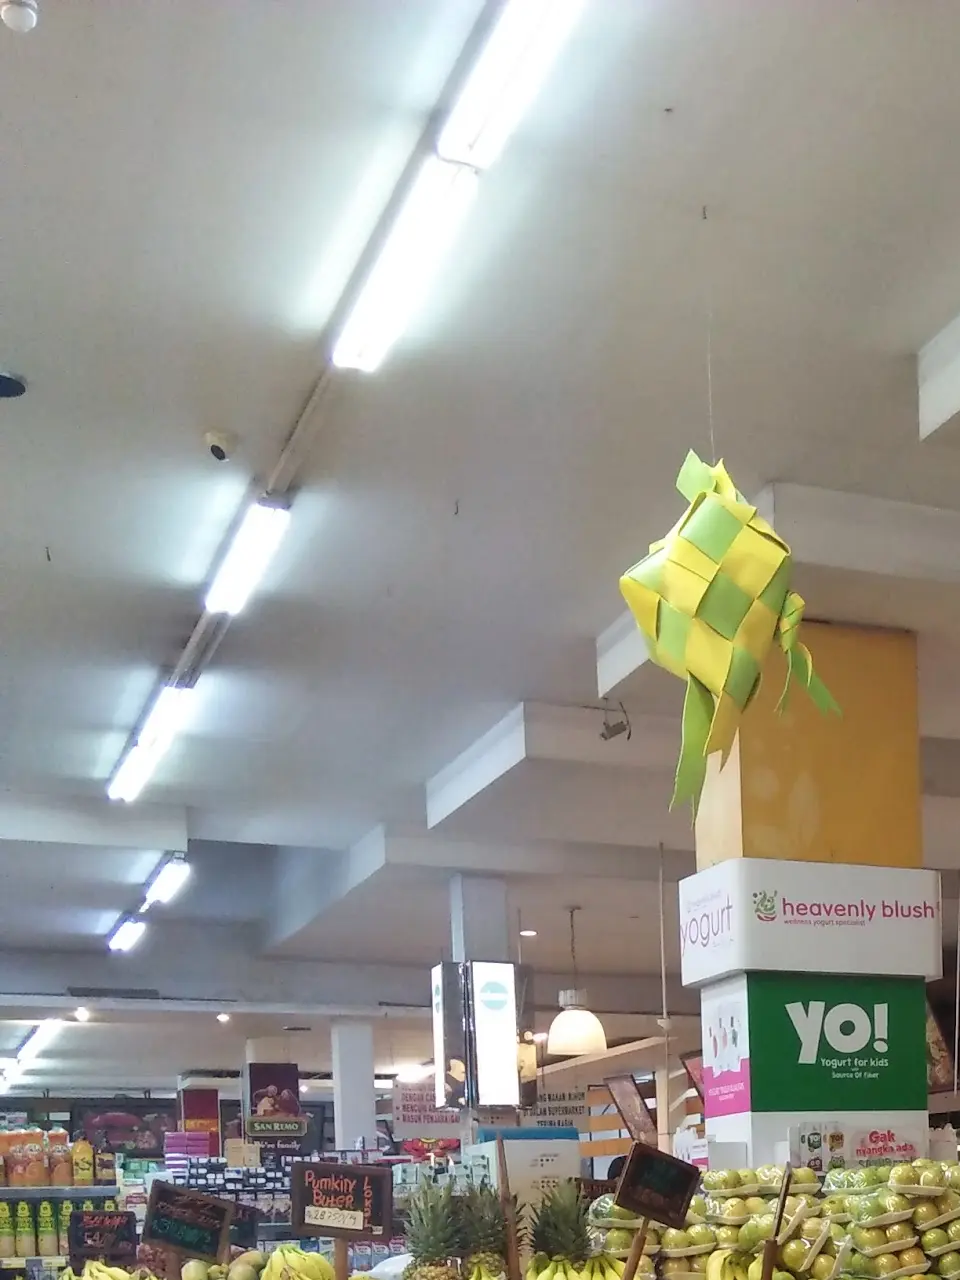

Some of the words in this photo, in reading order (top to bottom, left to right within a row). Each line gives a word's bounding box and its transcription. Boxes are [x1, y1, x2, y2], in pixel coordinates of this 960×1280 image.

[782, 898, 876, 921] heavenly
[881, 900, 935, 919] blush
[681, 893, 733, 957] yogurt
[785, 1000, 889, 1064] YO!
[820, 1058, 852, 1068] Yogurt
[854, 1058, 868, 1067] for
[870, 1058, 889, 1067] kids
[254, 1122, 272, 1131] SAN
[273, 1122, 299, 1131] REMO
[868, 1129, 895, 1144] Gak
[277, 1139, 301, 1151] family
[856, 1144, 894, 1157] nyangka
